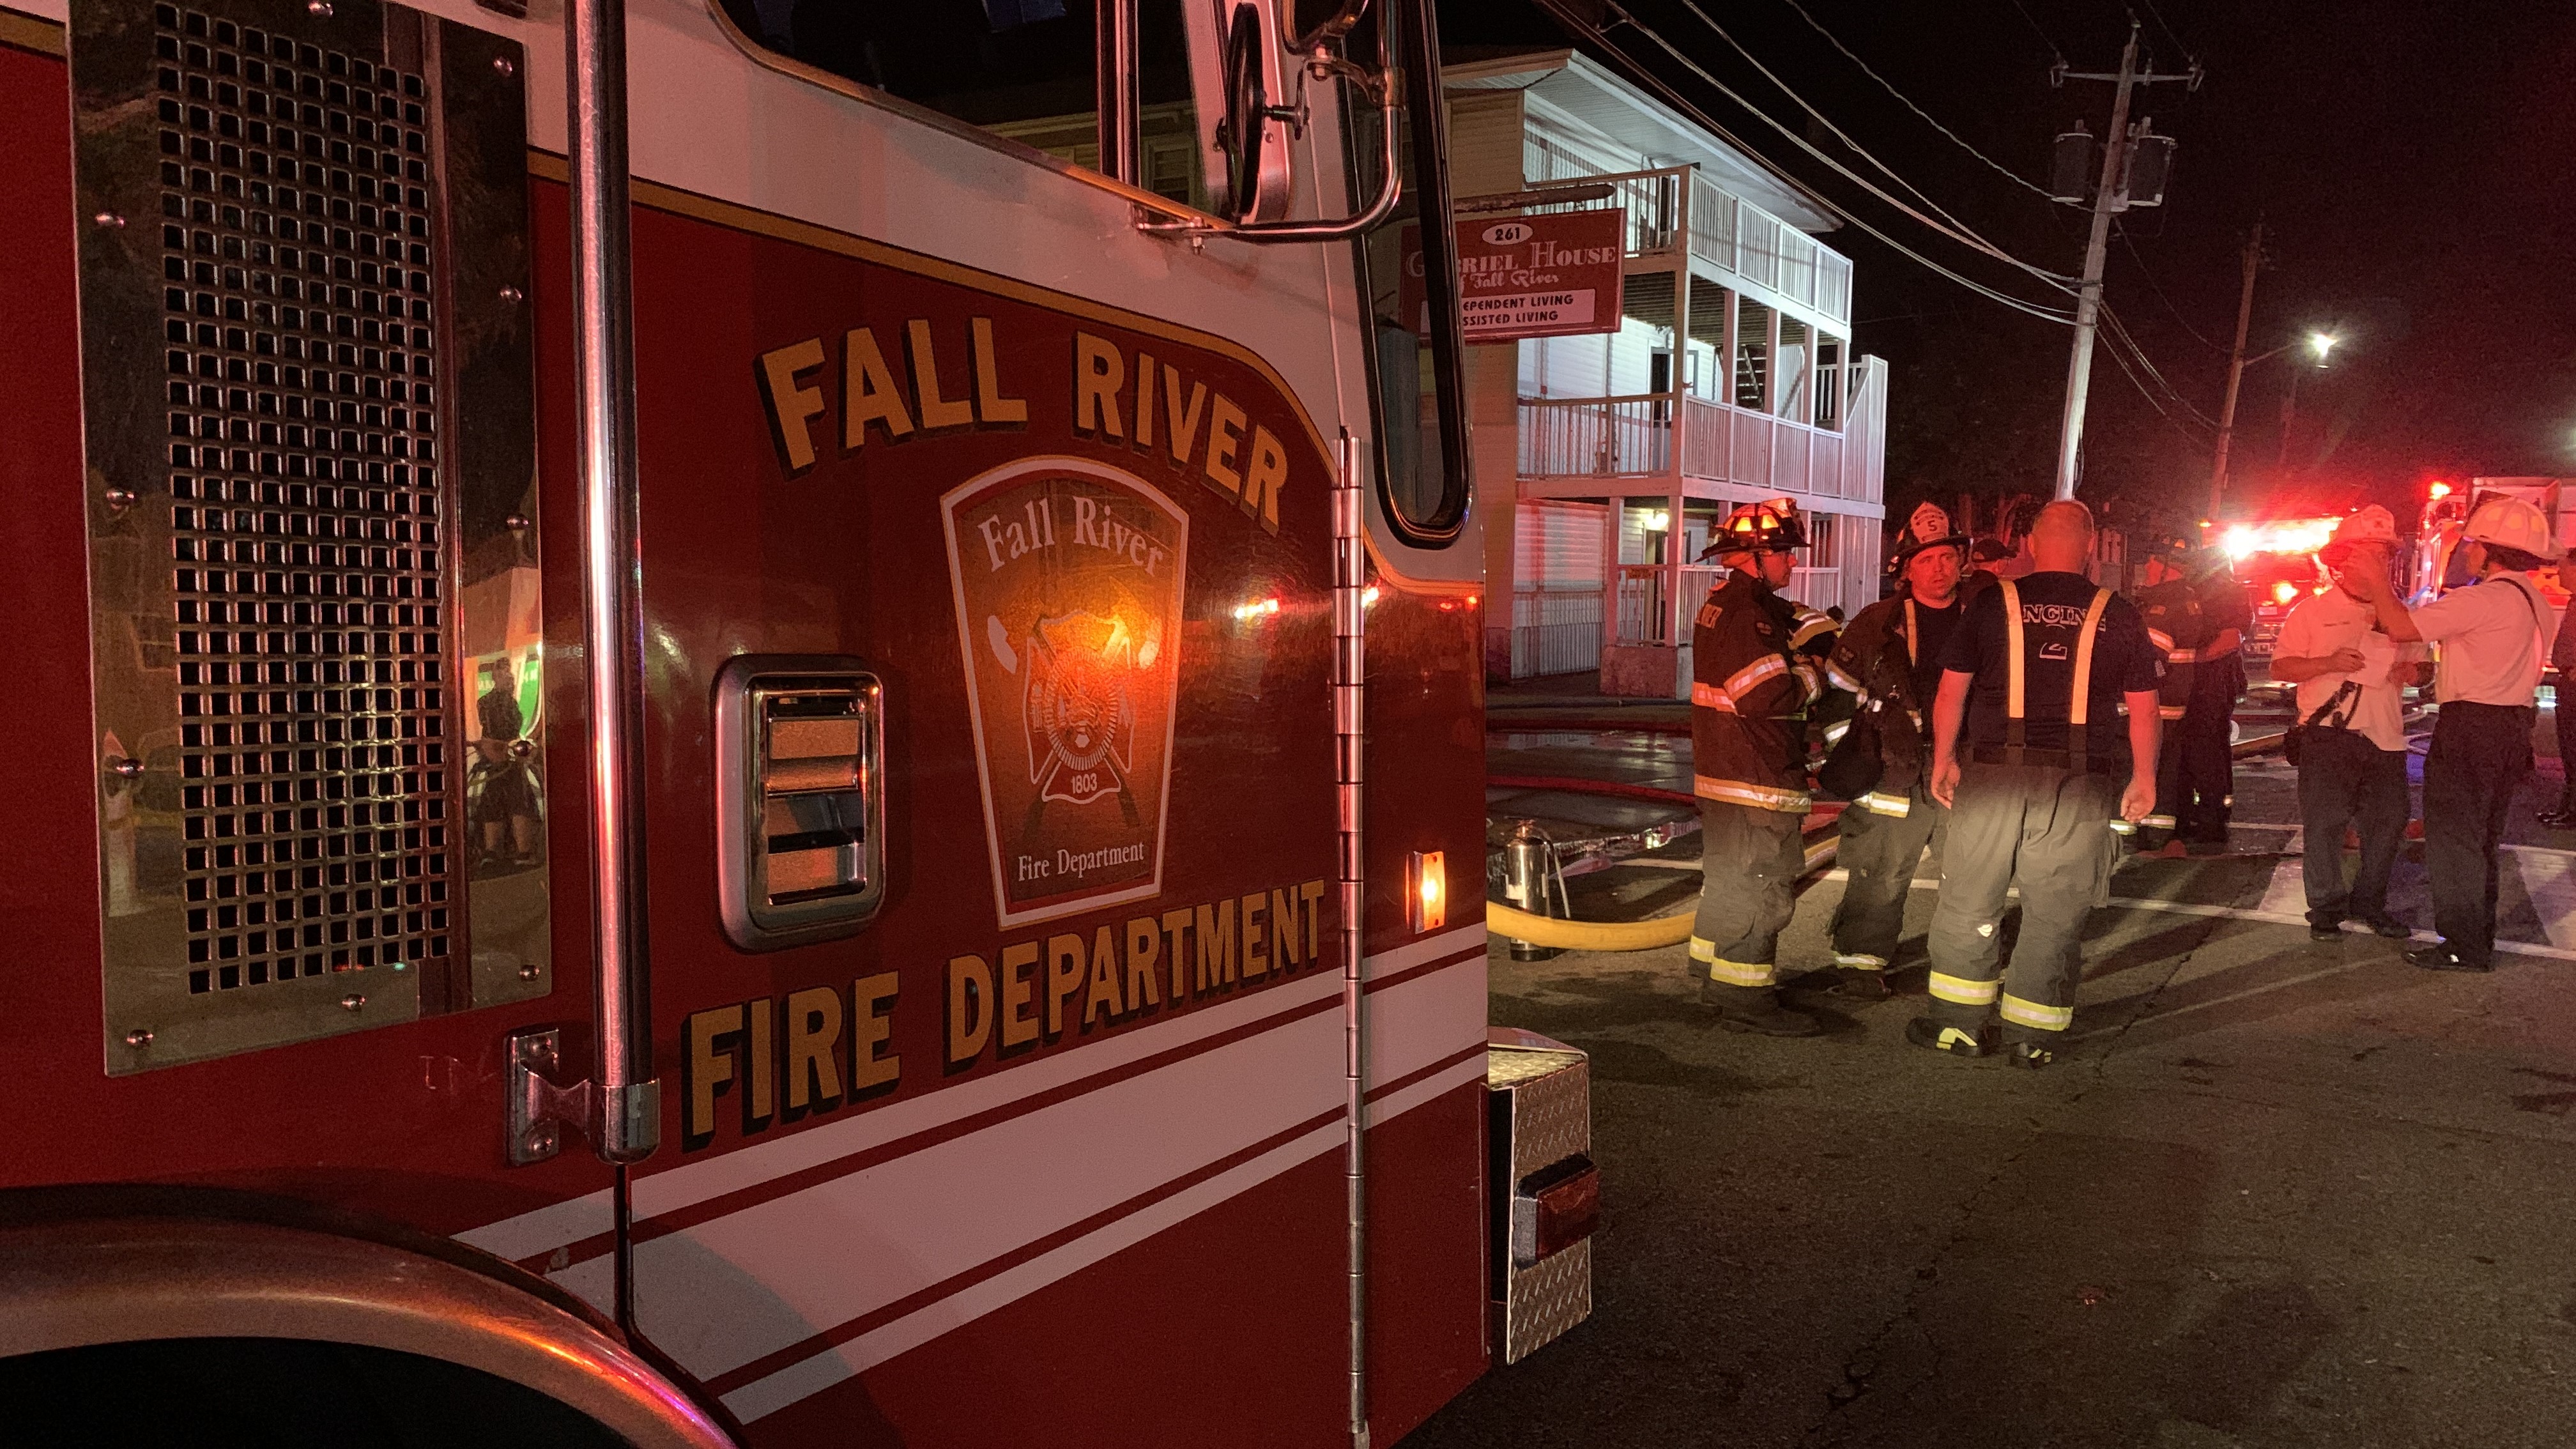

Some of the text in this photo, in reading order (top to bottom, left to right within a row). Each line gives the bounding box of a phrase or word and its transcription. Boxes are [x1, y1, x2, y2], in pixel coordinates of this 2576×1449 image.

[1495, 227, 1520, 241] 261
[1529, 240, 1616, 268] HOUSE
[1470, 272, 1505, 288] Fall
[1511, 269, 1560, 288] River
[1463, 295, 1574, 311] EPENDENT LIVING
[1463, 310, 1558, 326] SSISTED LIVING
[758, 317, 1288, 532] FALL RIVER
[977, 496, 1163, 576] Fall River
[2023, 604, 2106, 632] NGIN
[1071, 773, 1098, 794] 1803
[1018, 842, 1144, 881] Fire Department
[686, 879, 1325, 1141] FIRE DEPARTMENT
